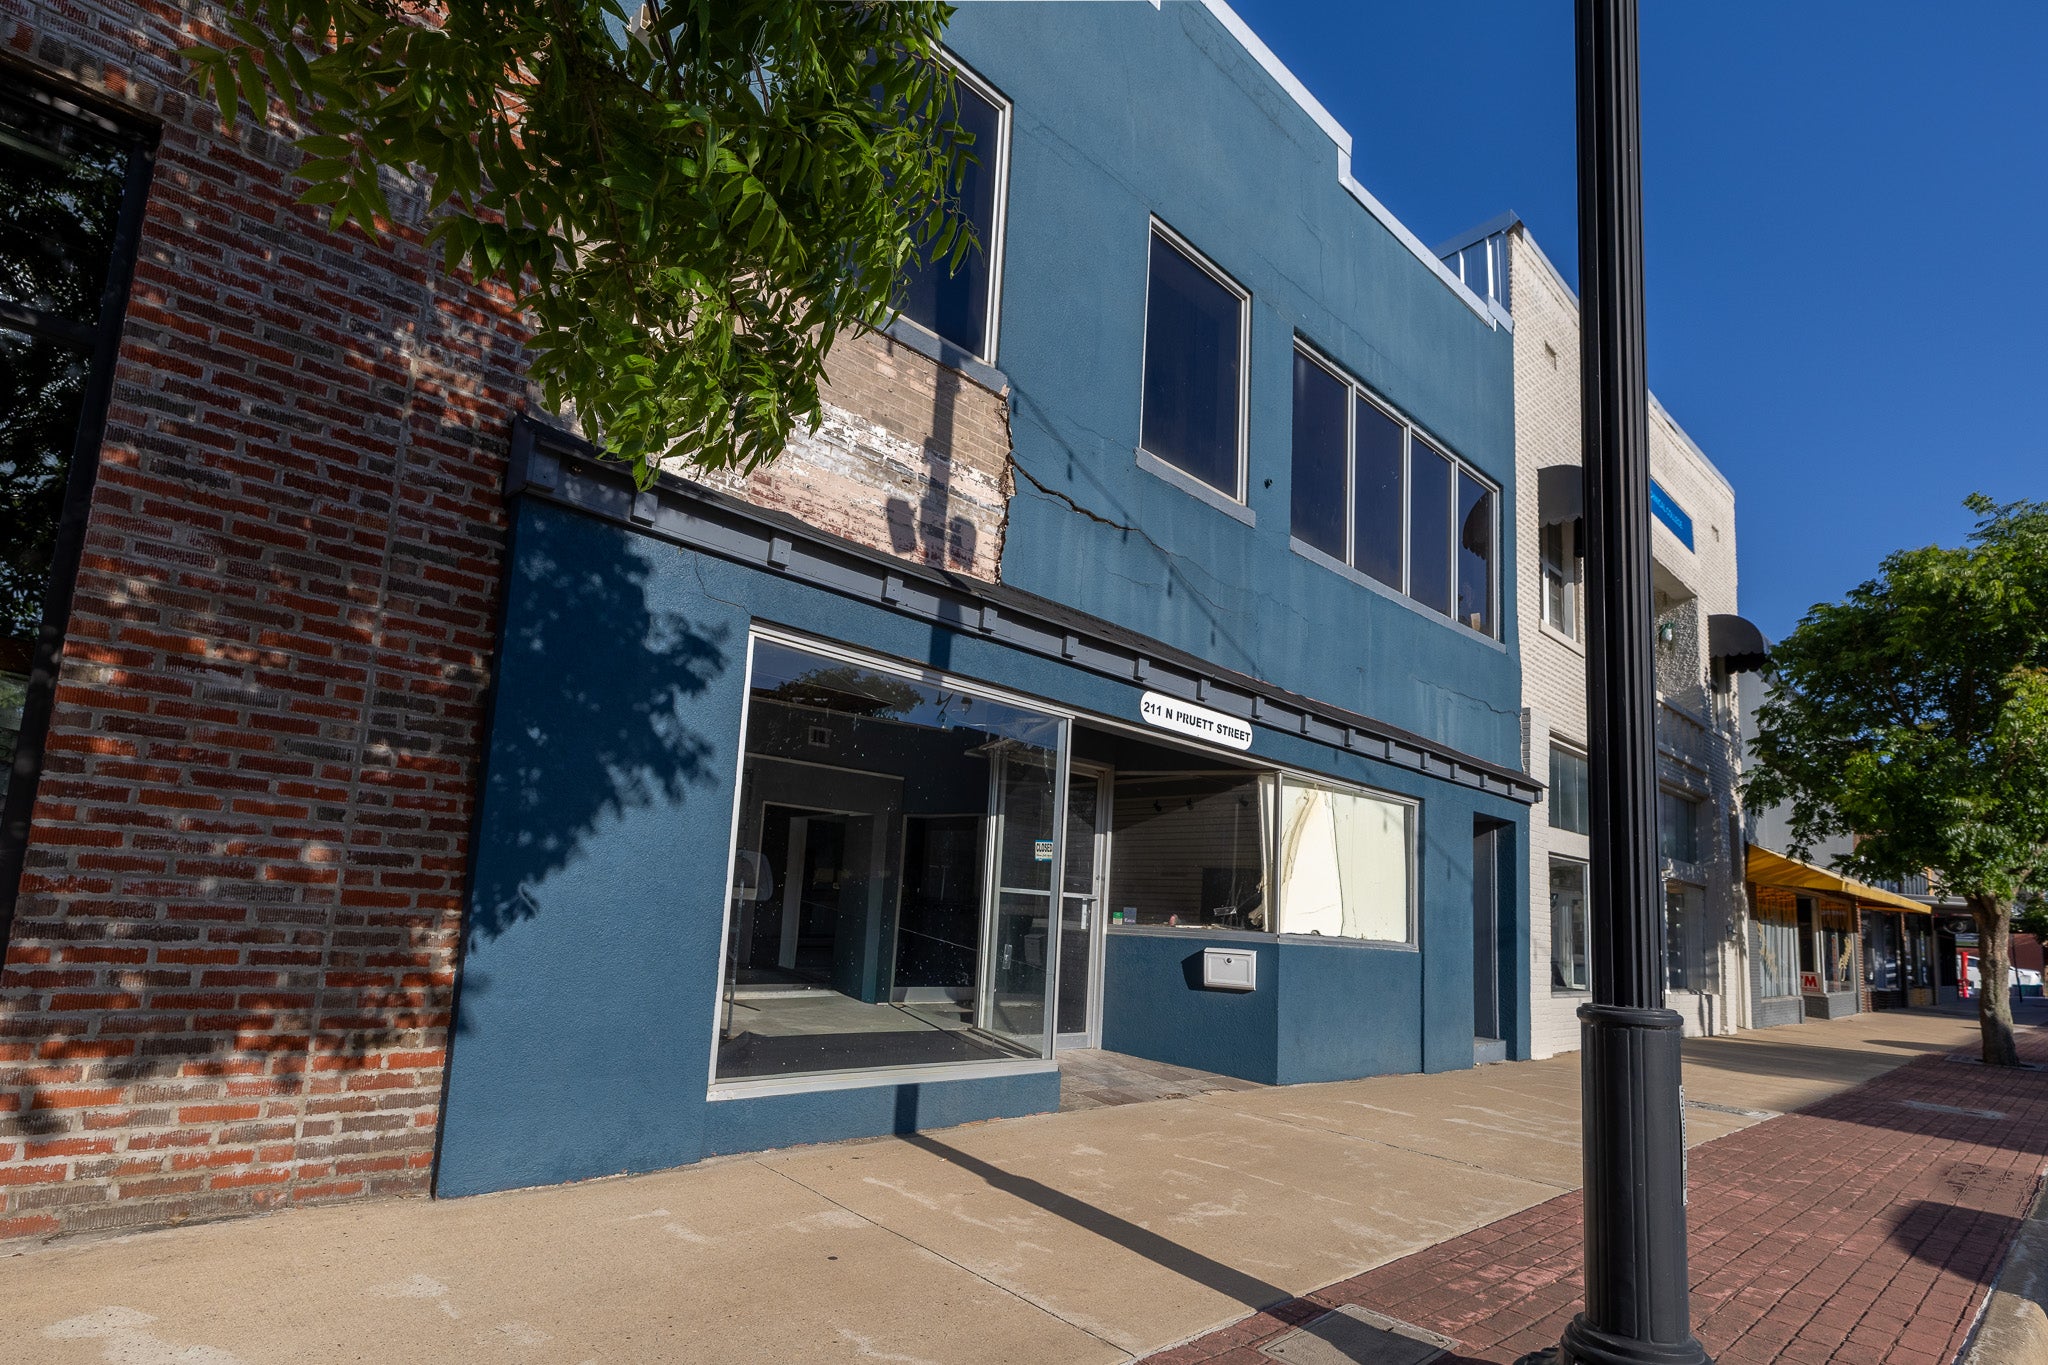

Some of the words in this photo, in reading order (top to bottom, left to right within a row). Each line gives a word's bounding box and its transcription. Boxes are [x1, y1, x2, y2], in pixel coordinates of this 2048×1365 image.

[1143, 701, 1162, 716] 211
[1165, 707, 1173, 720] N
[1176, 711, 1214, 731] PRUETT
[1216, 723, 1251, 742] STREET
[1036, 843, 1053, 852] CLOSED
